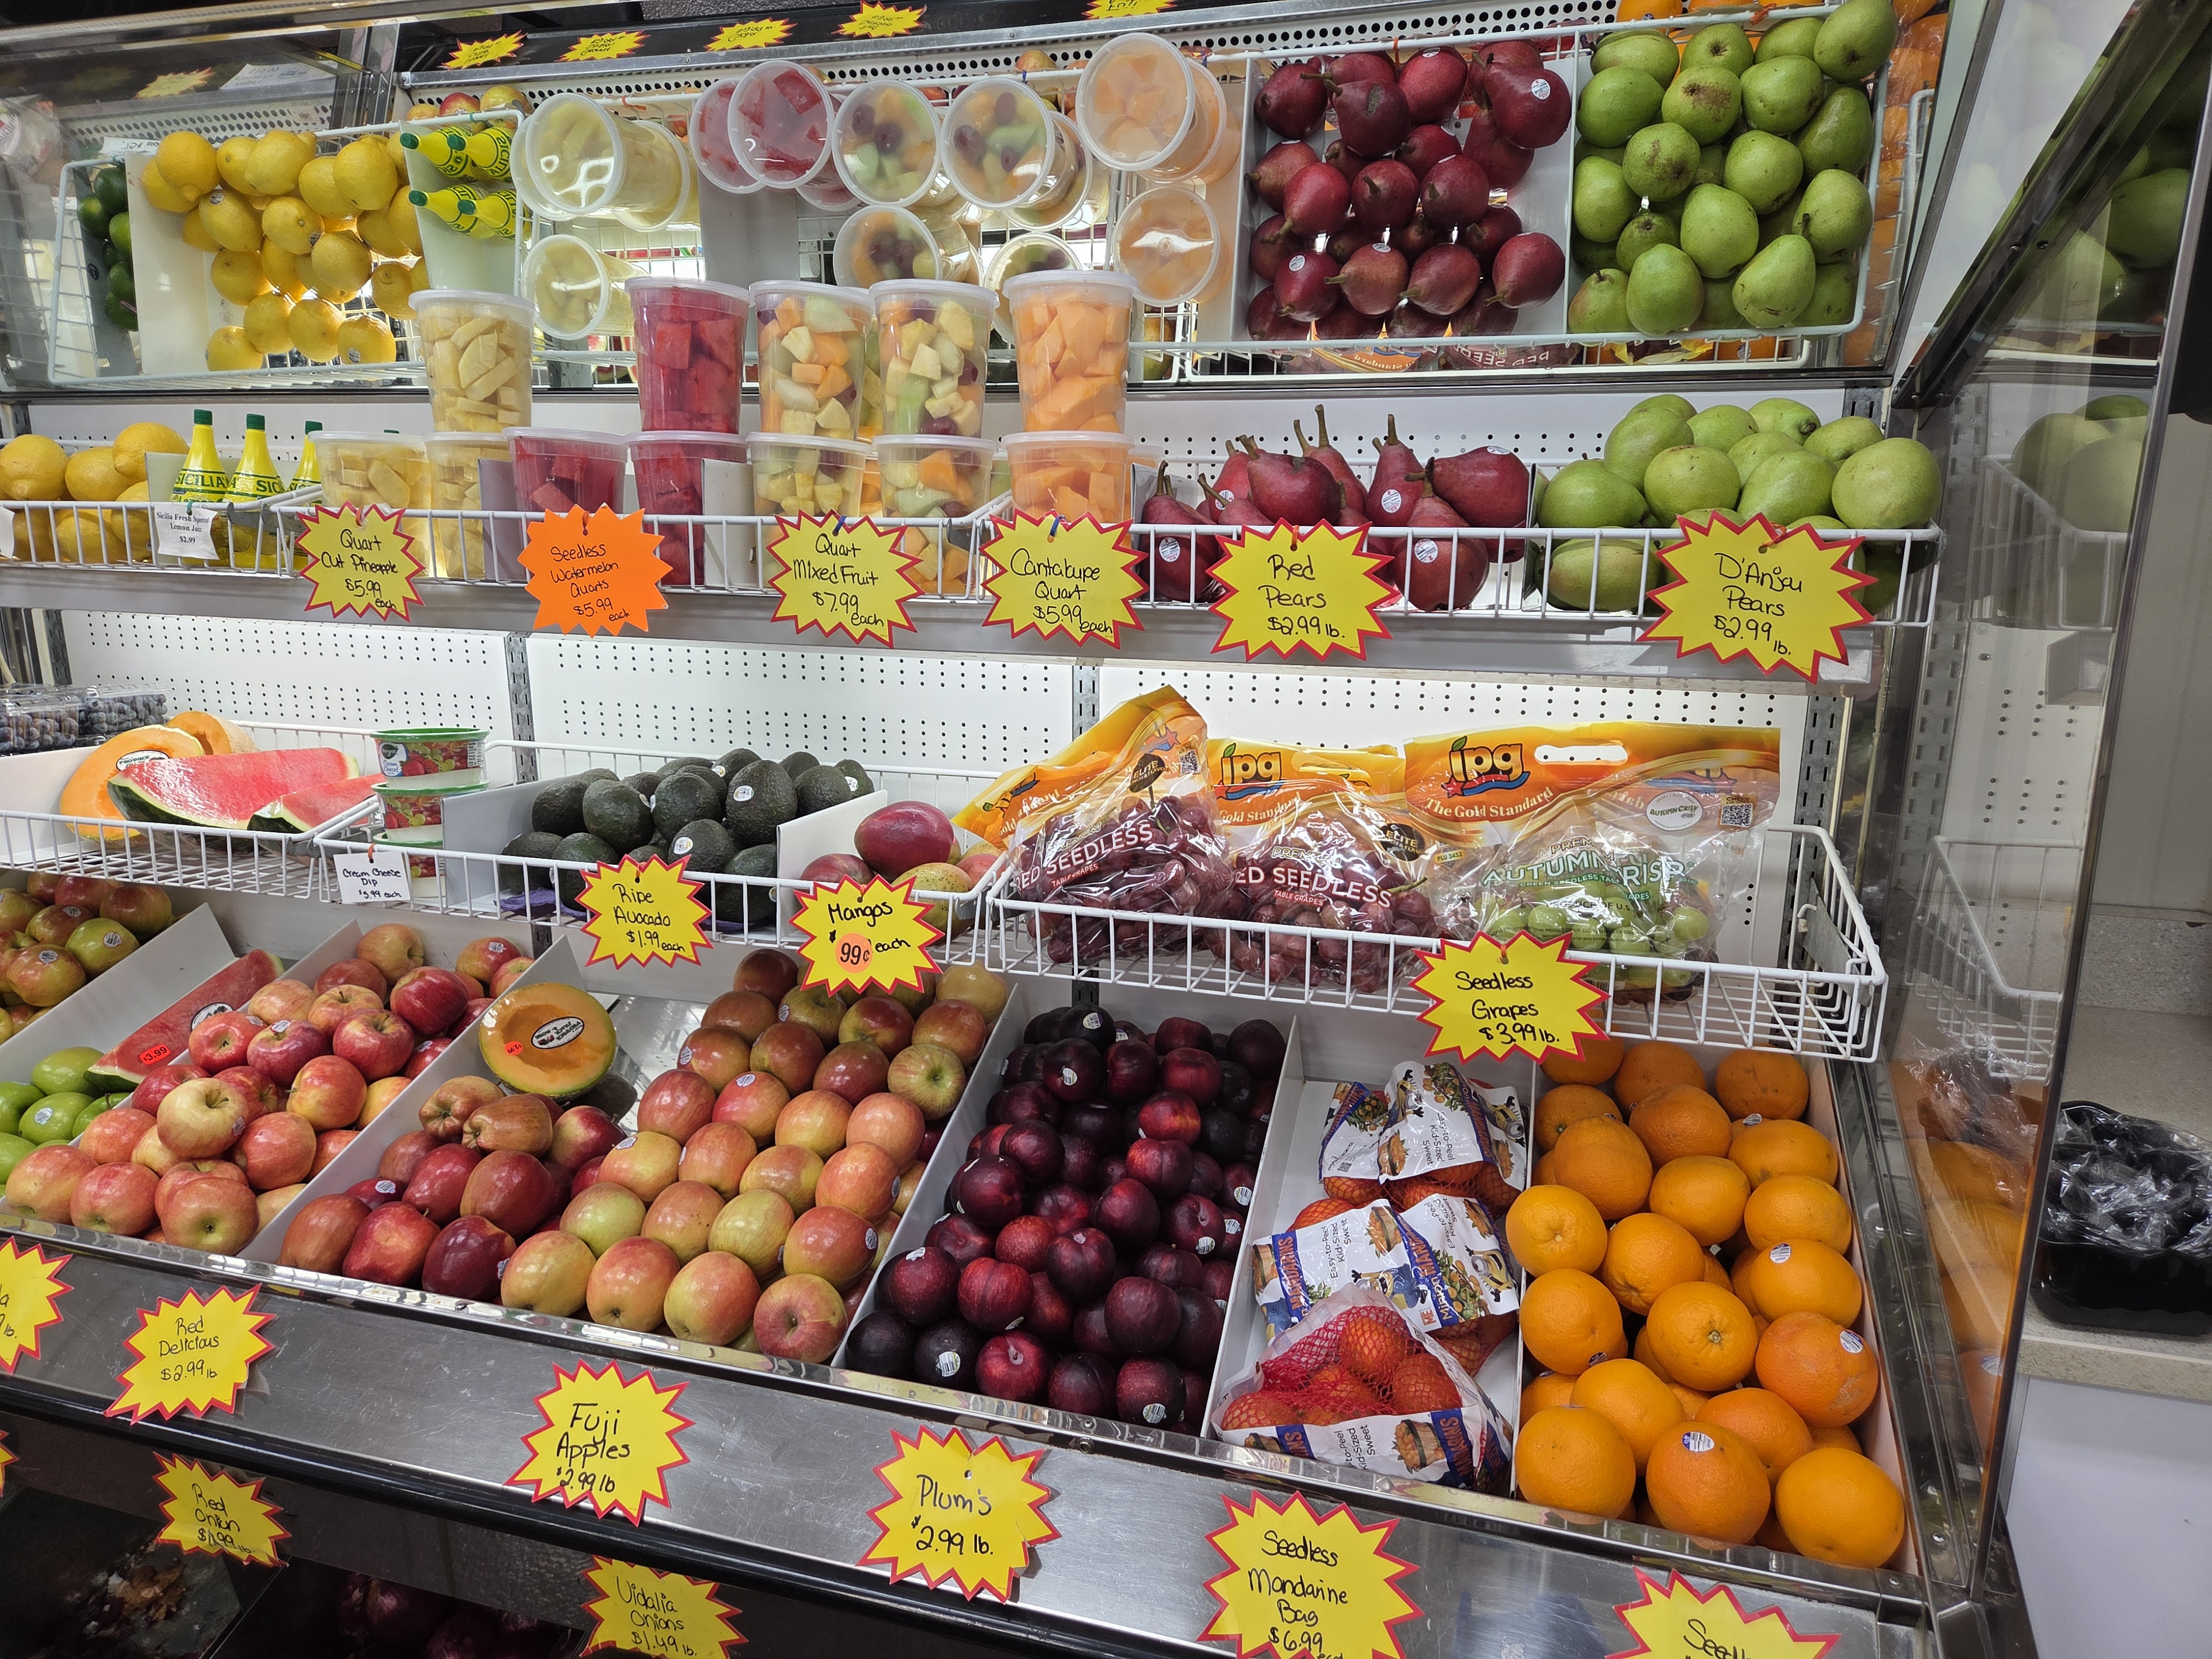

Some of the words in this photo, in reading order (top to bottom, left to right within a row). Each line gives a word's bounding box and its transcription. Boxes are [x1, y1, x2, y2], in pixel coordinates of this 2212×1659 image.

[175, 472, 226, 488] SICILIA
[156, 512, 173, 520] Sicilia
[174, 513, 191, 521] Fresh
[170, 522, 190, 531] Lemon
[179, 535, 196, 544] $2.99
[340, 529, 382, 551] Quart
[816, 533, 861, 557] Quart
[321, 551, 345, 568] Cut
[350, 554, 398, 575] Pineapple
[550, 544, 606, 562] Seedless
[550, 561, 619, 583] Watermelon
[794, 559, 839, 584] Mixed
[840, 565, 879, 586] Fruit
[1267, 554, 1316, 581] Red
[345, 578, 382, 598] $5.99
[571, 580, 609, 598] Quarts
[1035, 581, 1087, 601] Quart
[1258, 585, 1327, 609] Pears
[375, 598, 397, 609] each
[573, 597, 613, 617] $5.99
[812, 591, 859, 614] $7.99
[1723, 585, 1785, 616] Pears
[609, 609, 630, 622] each
[851, 613, 884, 627] each
[1033, 604, 1082, 624] $5.99
[1079, 620, 1113, 634] each
[1267, 615, 1321, 635] $2.99
[1325, 623, 1345, 638] lb.
[1714, 615, 1772, 641] $2.99
[1773, 640, 1792, 655] lb.
[119, 755, 150, 764] PRODUCE
[1133, 760, 1159, 779] ELITE
[1449, 742, 1524, 783] ipg
[1425, 796, 1453, 817] The
[1454, 804, 1487, 818] Gold
[1489, 786, 1554, 817] Standard
[1046, 824, 1153, 874] SEEDLESS
[1385, 830, 1418, 847] ELITE
[1437, 853, 1448, 862] PLU
[342, 868, 370, 878] Cream
[372, 868, 401, 878] Cheese
[1072, 863, 1099, 879] GRAPES
[1679, 877, 1699, 885] BRAND
[384, 890, 402, 899] each
[612, 883, 654, 904] Ripe
[1273, 867, 1392, 908] SEEDLESS
[1274, 890, 1293, 900] TABLE
[1293, 893, 1324, 906] GRAPES
[613, 905, 671, 926] Avocado
[828, 901, 893, 927] Mangos
[626, 930, 660, 948] $1.99
[661, 942, 686, 952] each
[840, 942, 870, 966] 99¢
[875, 938, 911, 953] each
[1455, 971, 1534, 990] Seedless
[1472, 999, 1539, 1020] Grapes
[1478, 1022, 1537, 1045] $3.99
[1538, 1027, 1560, 1043] lb.
[507, 1044, 522, 1054] $2.99
[1422, 1140, 1433, 1165] Sweet
[1430, 1124, 1445, 1162] Kid-Sized
[1433, 1198, 1456, 1237] Kid-Sized
[1442, 1197, 1457, 1223] Sweet
[1340, 1218, 1352, 1245] Sweet
[1423, 1202, 1455, 1249] Easy-to-Peel
[1321, 1226, 1338, 1279] Easy-to-Peel
[1331, 1222, 1345, 1263] Kid-Sized
[1430, 1276, 1453, 1321] Minion
[175, 1315, 205, 1336] Red
[1420, 1308, 1437, 1326] ME
[159, 1335, 220, 1357] Delicious
[160, 1359, 205, 1382] $2.99
[570, 1403, 620, 1445] Fuji
[556, 1431, 630, 1469] Apples
[1358, 1424, 1376, 1456] Sweet
[556, 1466, 597, 1491] $2.99
[599, 1474, 615, 1493] lb
[191, 1483, 228, 1517] Red
[916, 1473, 992, 1516] Plum's
[195, 1508, 241, 1532] Onion
[911, 1514, 964, 1556] $2.99
[974, 1533, 994, 1555] lb.
[1261, 1530, 1339, 1567] Seedless
[616, 1575, 679, 1614] Vidalia
[630, 1609, 685, 1631] Onions
[1276, 1598, 1319, 1627] Bag
[630, 1630, 679, 1653] $1.49
[682, 1644, 698, 1657] lb.
[1267, 1626, 1323, 1654] $6.99
